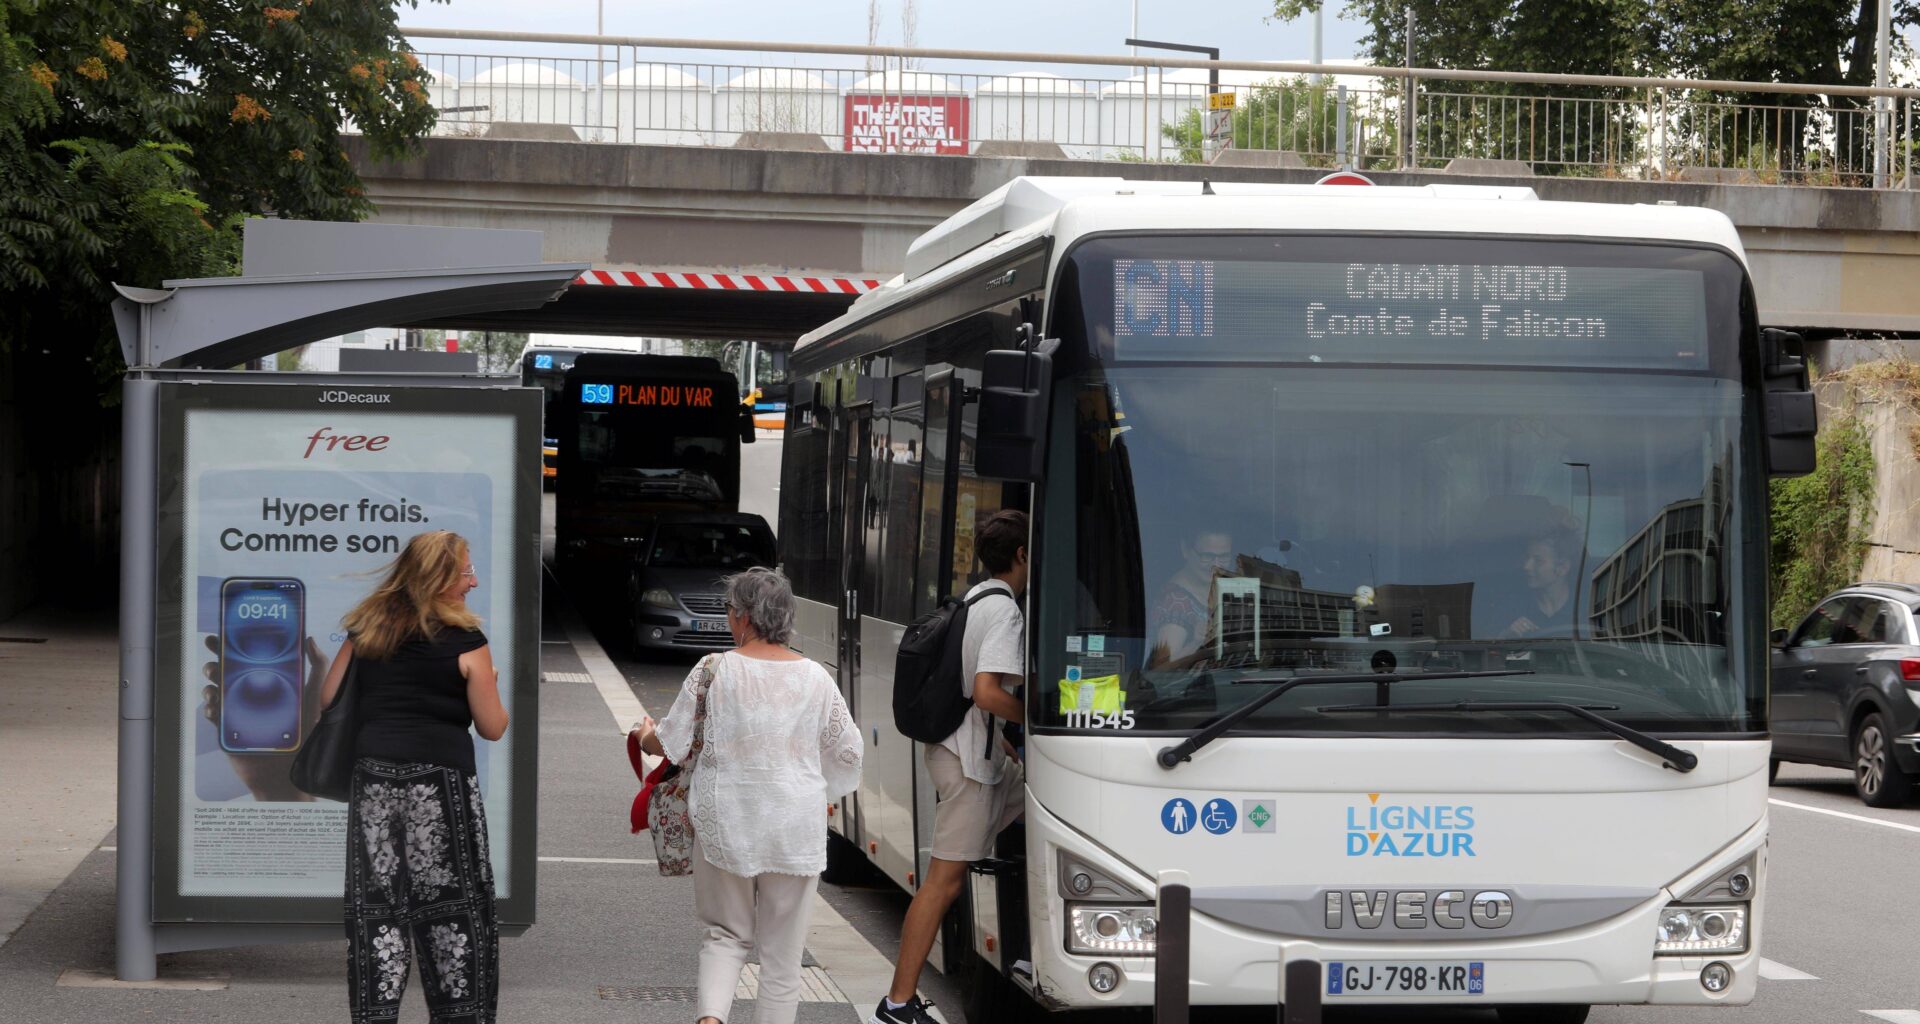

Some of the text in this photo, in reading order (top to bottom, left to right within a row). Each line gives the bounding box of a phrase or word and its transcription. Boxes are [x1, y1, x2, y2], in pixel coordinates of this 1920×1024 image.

[851, 125, 962, 147] NATIONAL
[1473, 265, 1567, 300] NORD
[1126, 263, 1203, 334] CN
[1307, 302, 1605, 339] Comte de Falicon
[535, 354, 552, 369] 22
[318, 390, 391, 404] JCDecaux
[583, 384, 713, 407] 59 PLAN DU VAR
[303, 427, 390, 459] free
[262, 497, 429, 527] Hyper frais.
[220, 528, 399, 553] Comme son
[237, 603, 287, 619] 09:41
[1064, 709, 1135, 730] 111545
[1251, 812, 1268, 821] CNG
[1346, 804, 1475, 830] LIGNES
[1346, 832, 1476, 857] D'AZUR
[1325, 890, 1514, 930] IVECO
[1332, 966, 1482, 991] F GJ-798-KR 06
